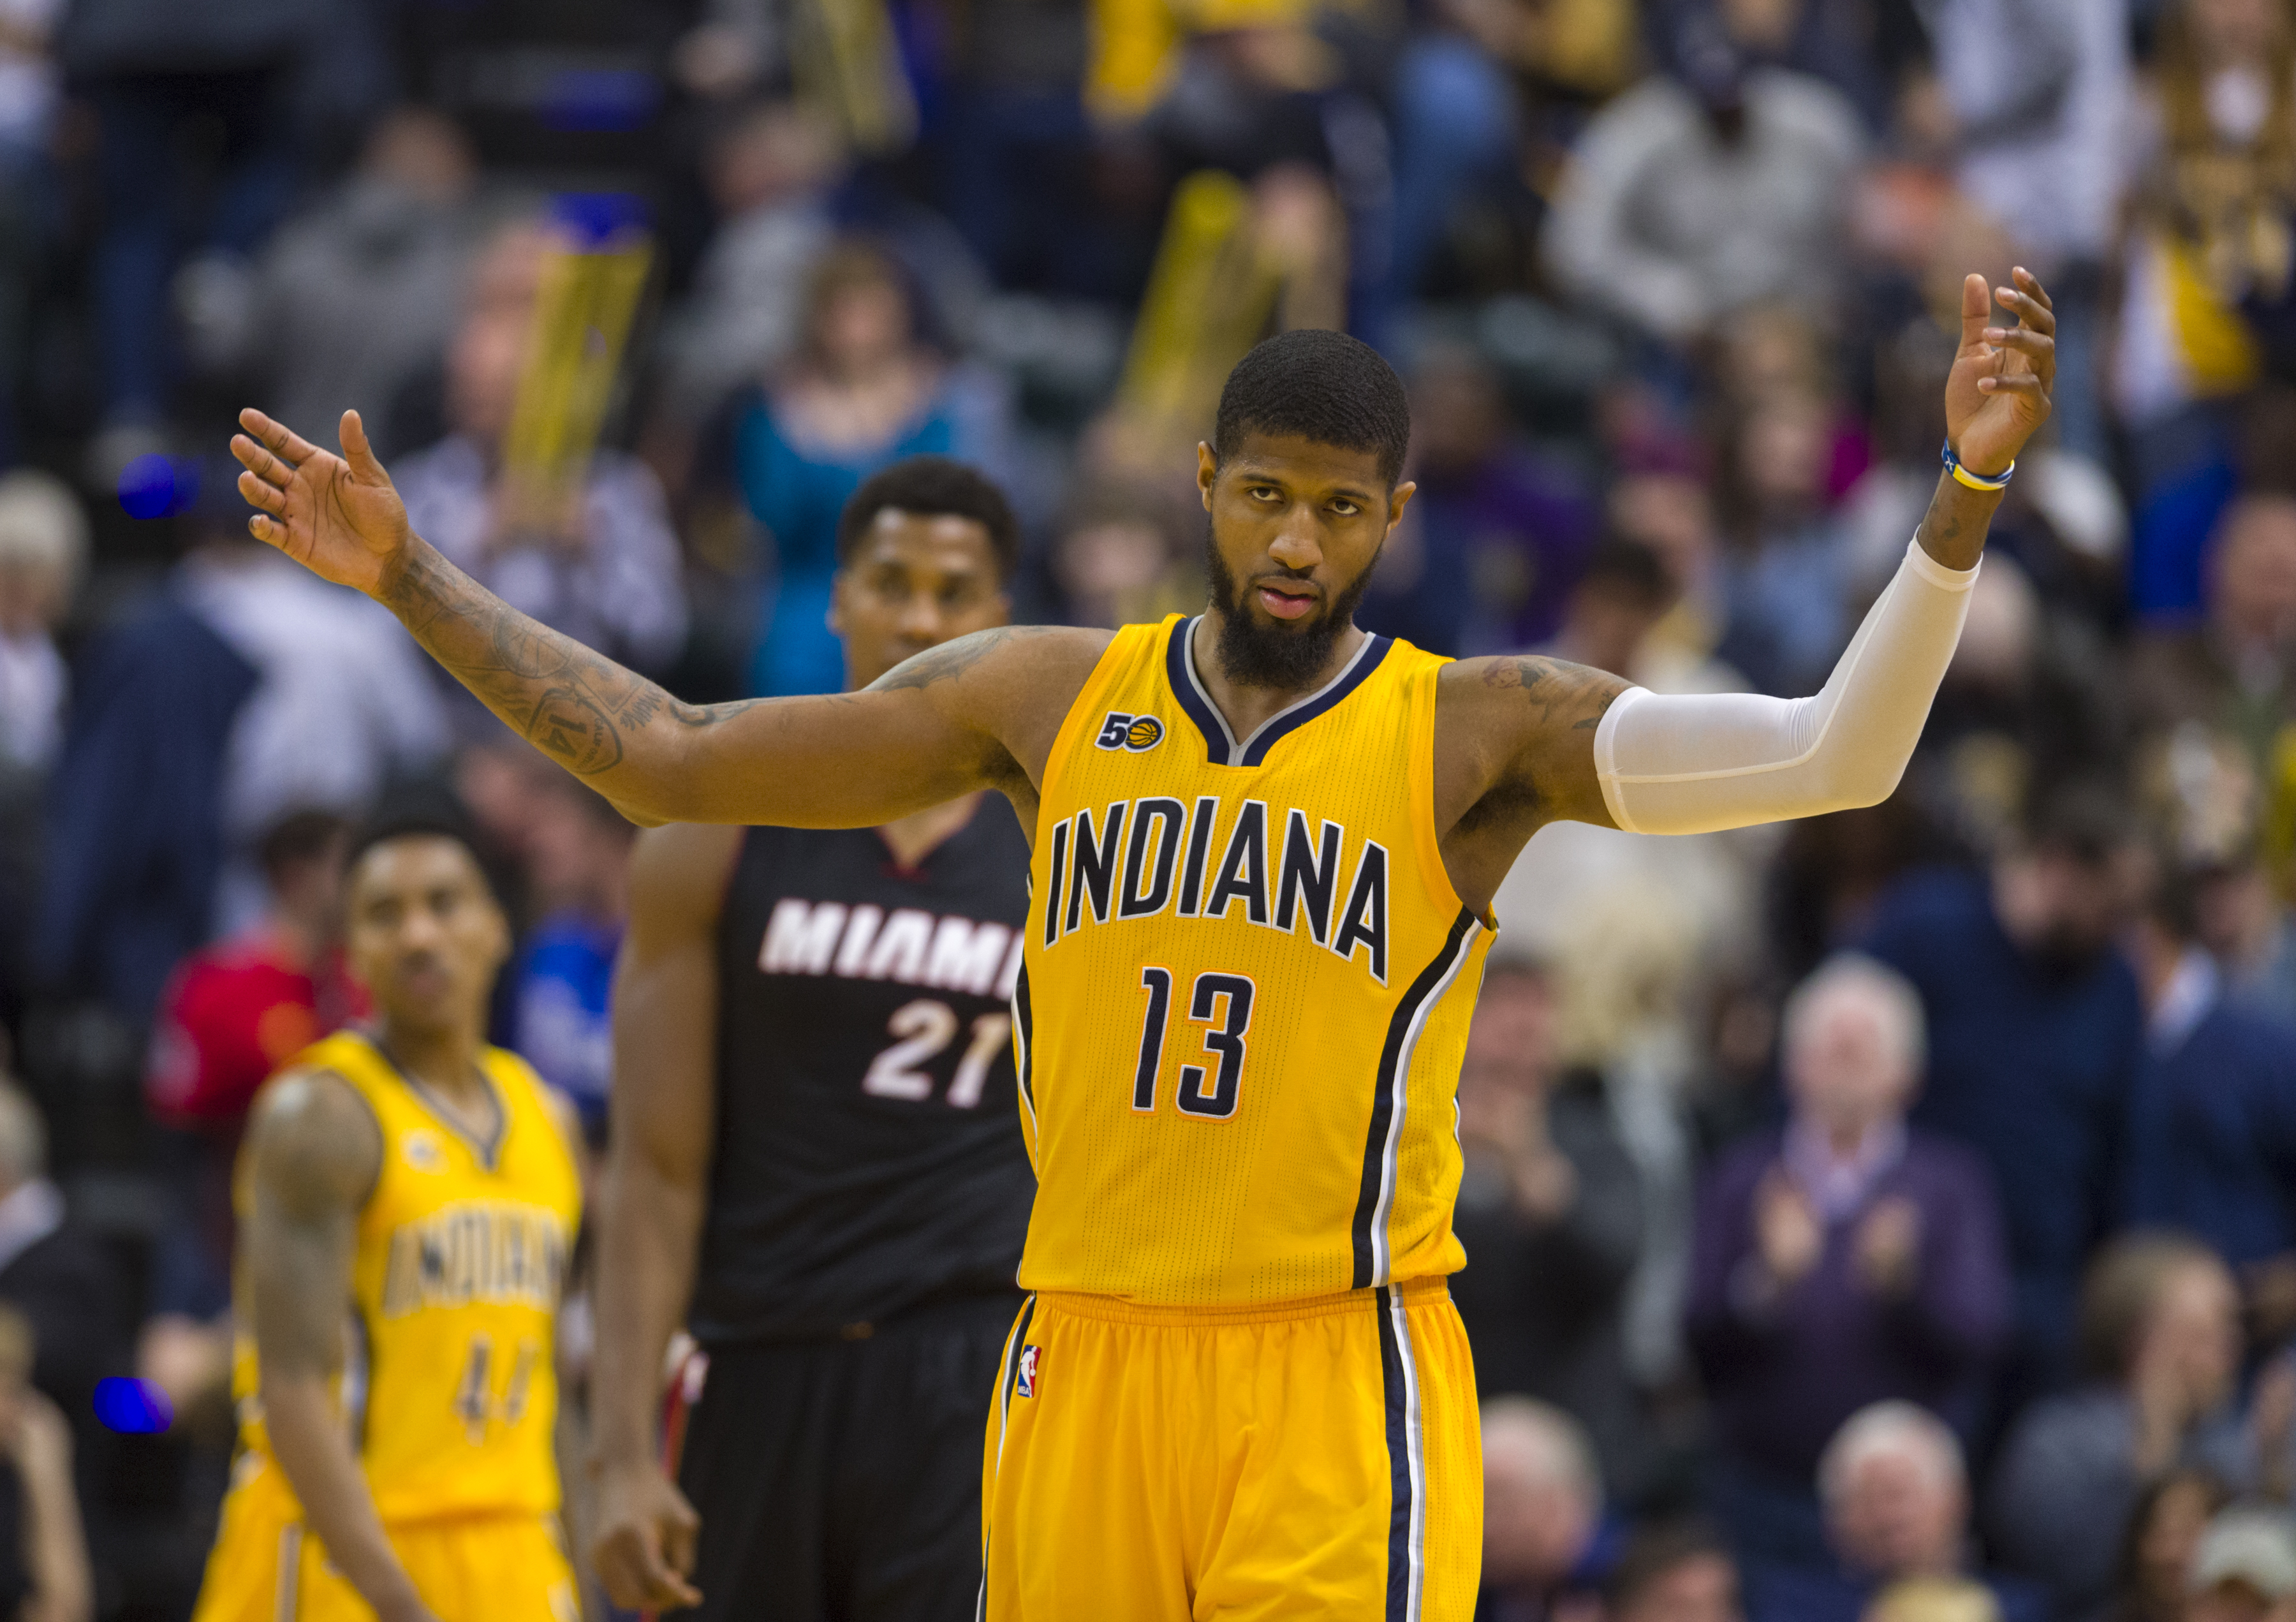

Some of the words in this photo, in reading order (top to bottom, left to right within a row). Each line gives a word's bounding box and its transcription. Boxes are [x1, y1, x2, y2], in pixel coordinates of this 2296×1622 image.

[540, 713, 587, 758] 14
[1094, 711, 1166, 753] 50
[1043, 795, 1389, 989] INDIANA
[862, 998, 1014, 1109] 21
[1130, 964, 1256, 1122] 13
[1018, 1385, 1029, 1396] NBA
